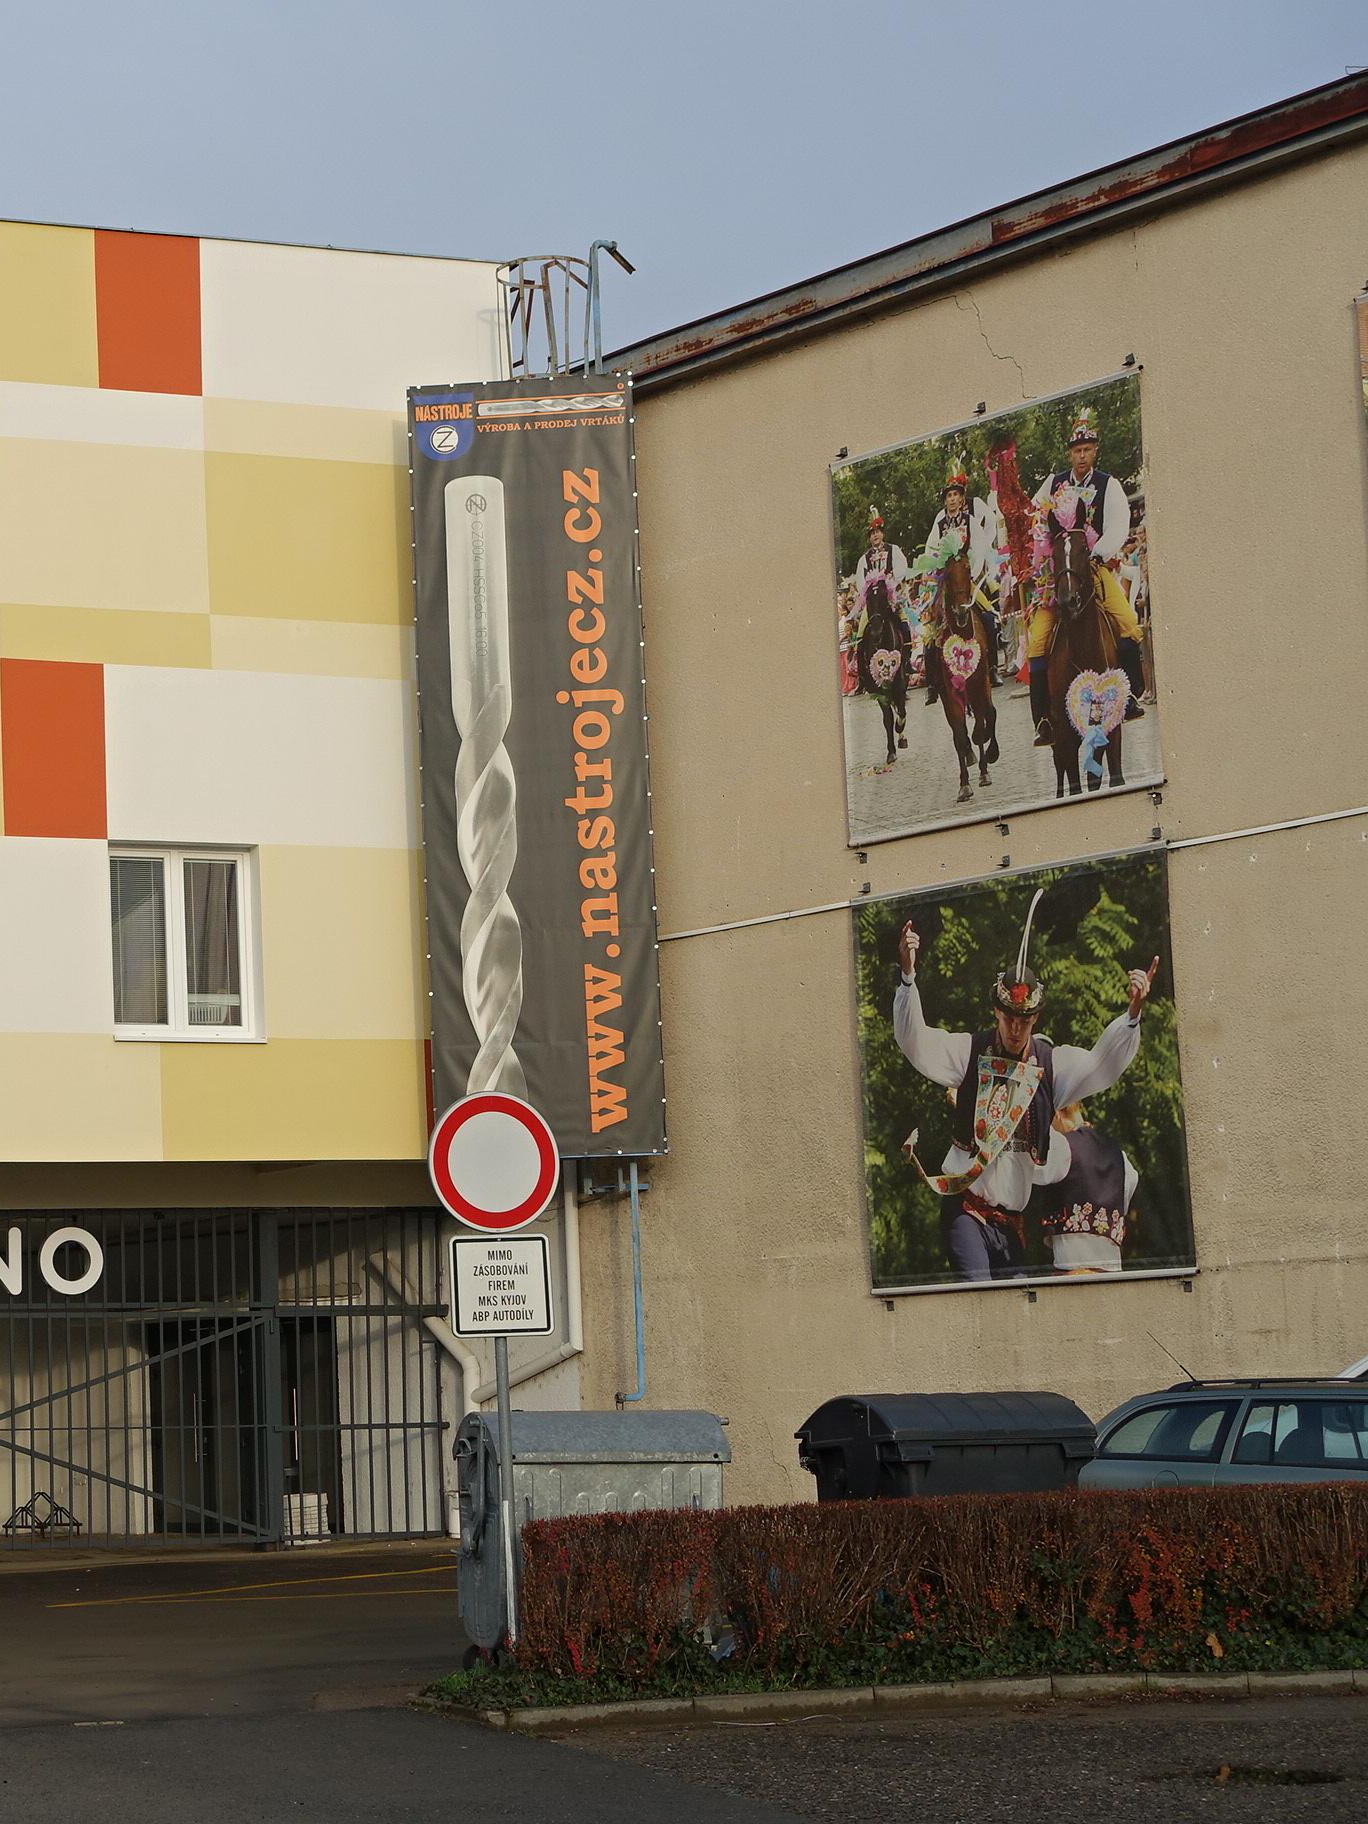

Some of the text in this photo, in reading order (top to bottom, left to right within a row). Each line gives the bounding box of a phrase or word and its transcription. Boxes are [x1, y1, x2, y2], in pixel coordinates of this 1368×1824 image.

[415, 403, 473, 422] NÁSTROJE
[477, 422, 521, 433] VÝROBA
[524, 422, 531, 430] A
[534, 419, 577, 430] PRODEJ
[556, 466, 629, 1134] www.nastrojecz.cz
[487, 1249, 513, 1261] MIMO
[473, 1262, 528, 1276] ZÁSOBOVÁNÍ
[488, 1280, 515, 1291] FIREM
[478, 1294, 526, 1306] MKS KYJOV
[472, 1308, 534, 1321] ABP AUTODÍLY
